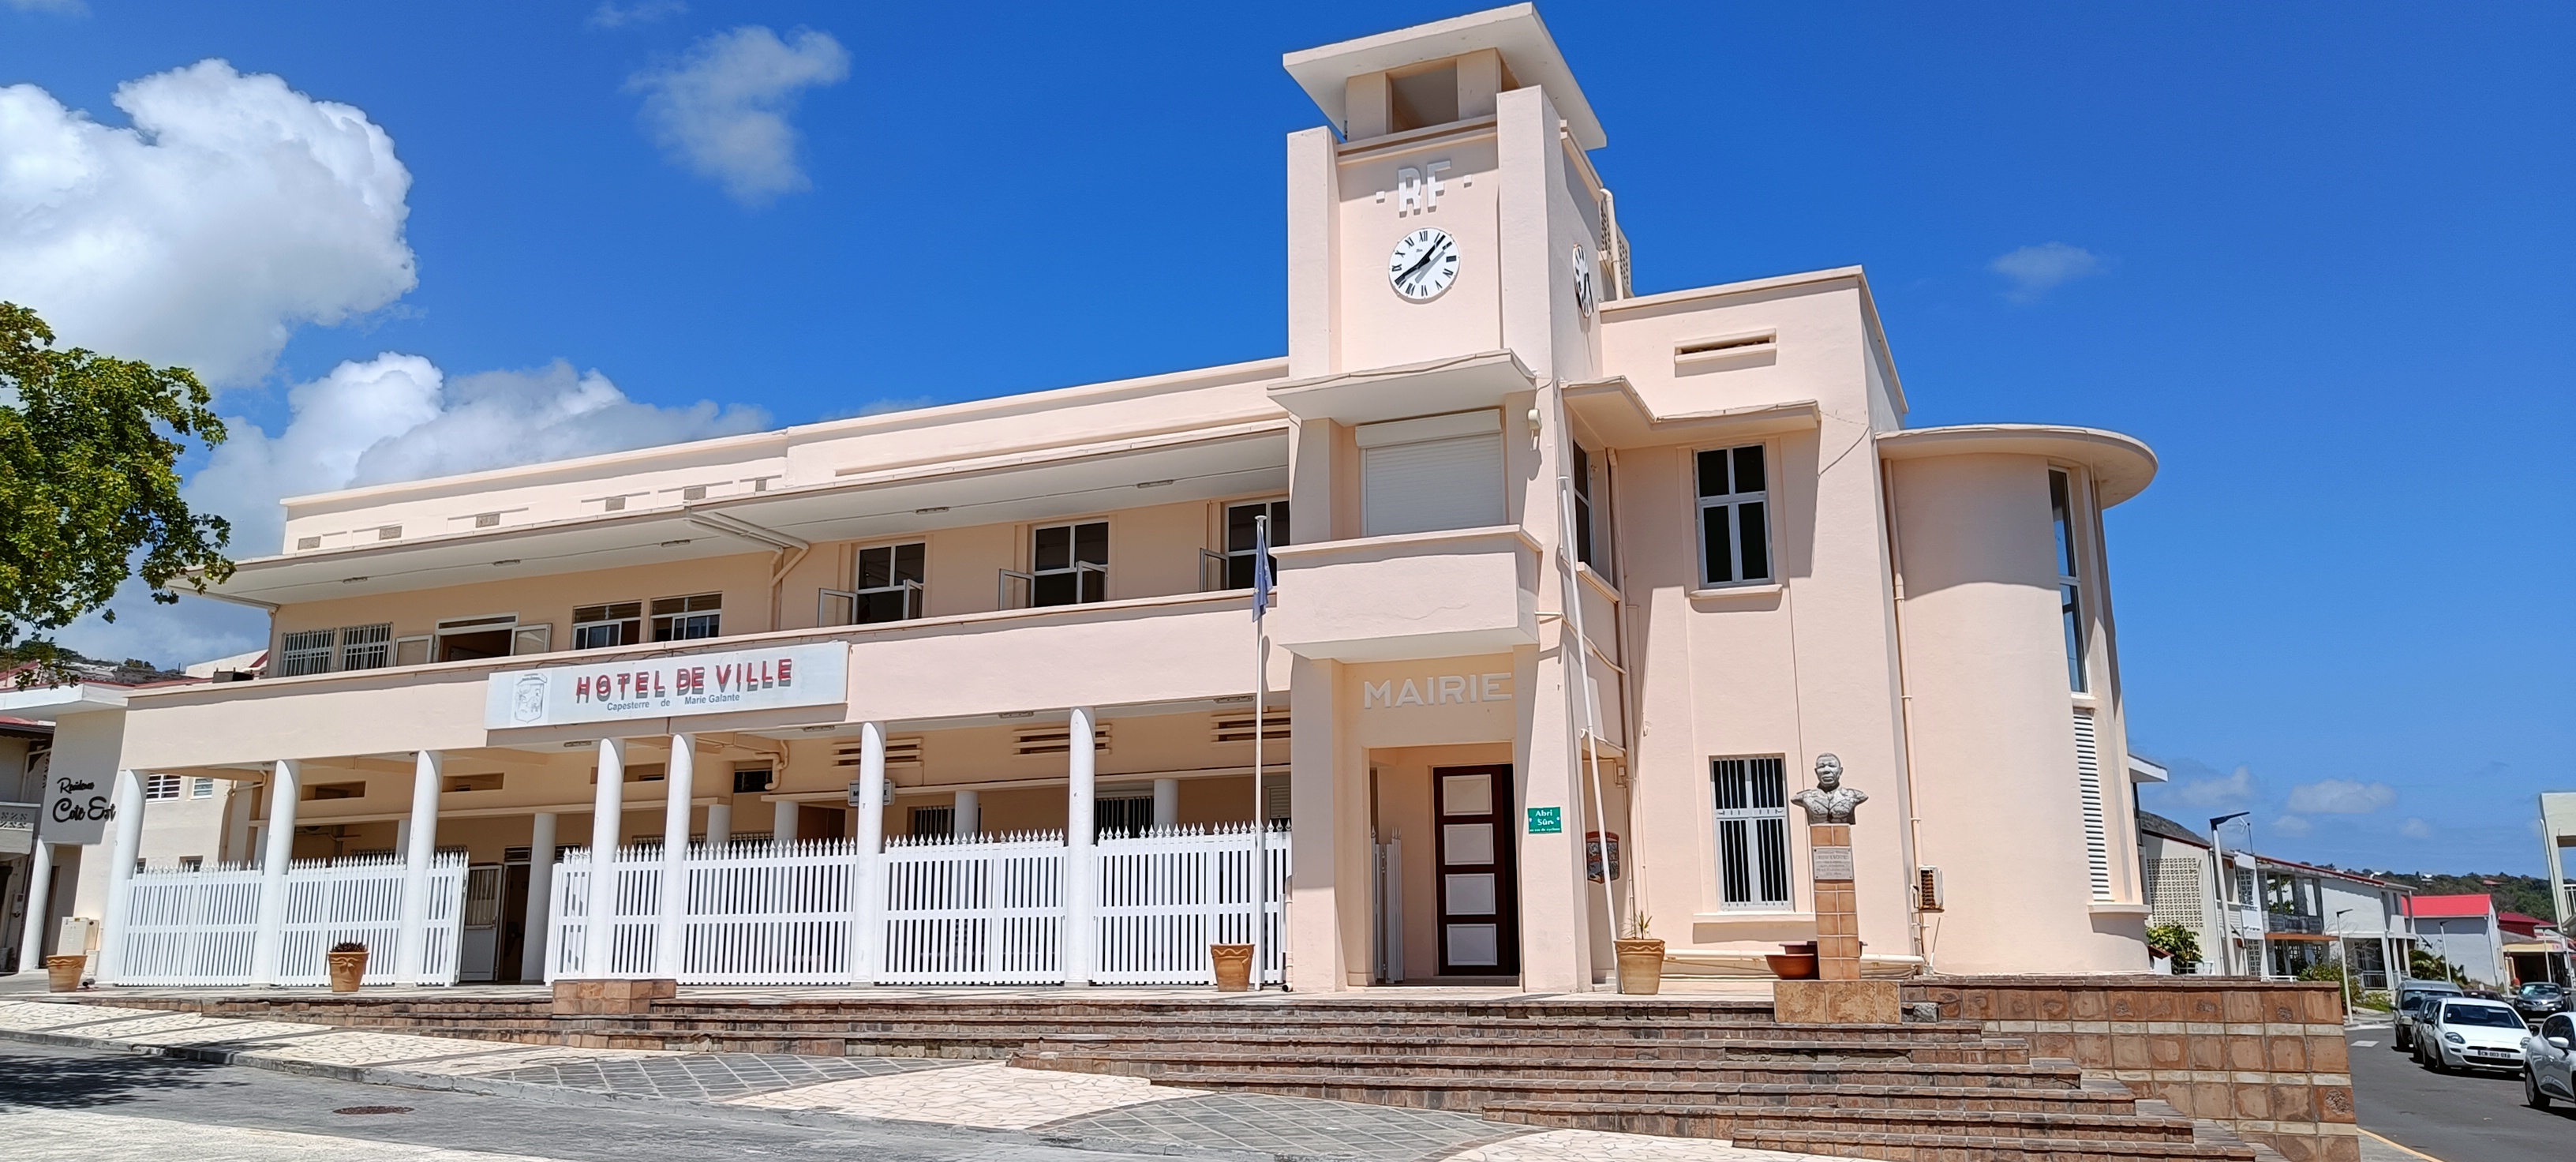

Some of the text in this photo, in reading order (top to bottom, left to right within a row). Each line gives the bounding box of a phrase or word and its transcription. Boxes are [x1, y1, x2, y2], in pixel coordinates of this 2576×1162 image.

[1398, 160, 1451, 215] RF
[576, 658, 792, 699] HOTEL DE VILLE
[1364, 672, 1512, 710] MAIRIE
[607, 693, 740, 712] Capesterre de Marie Galante
